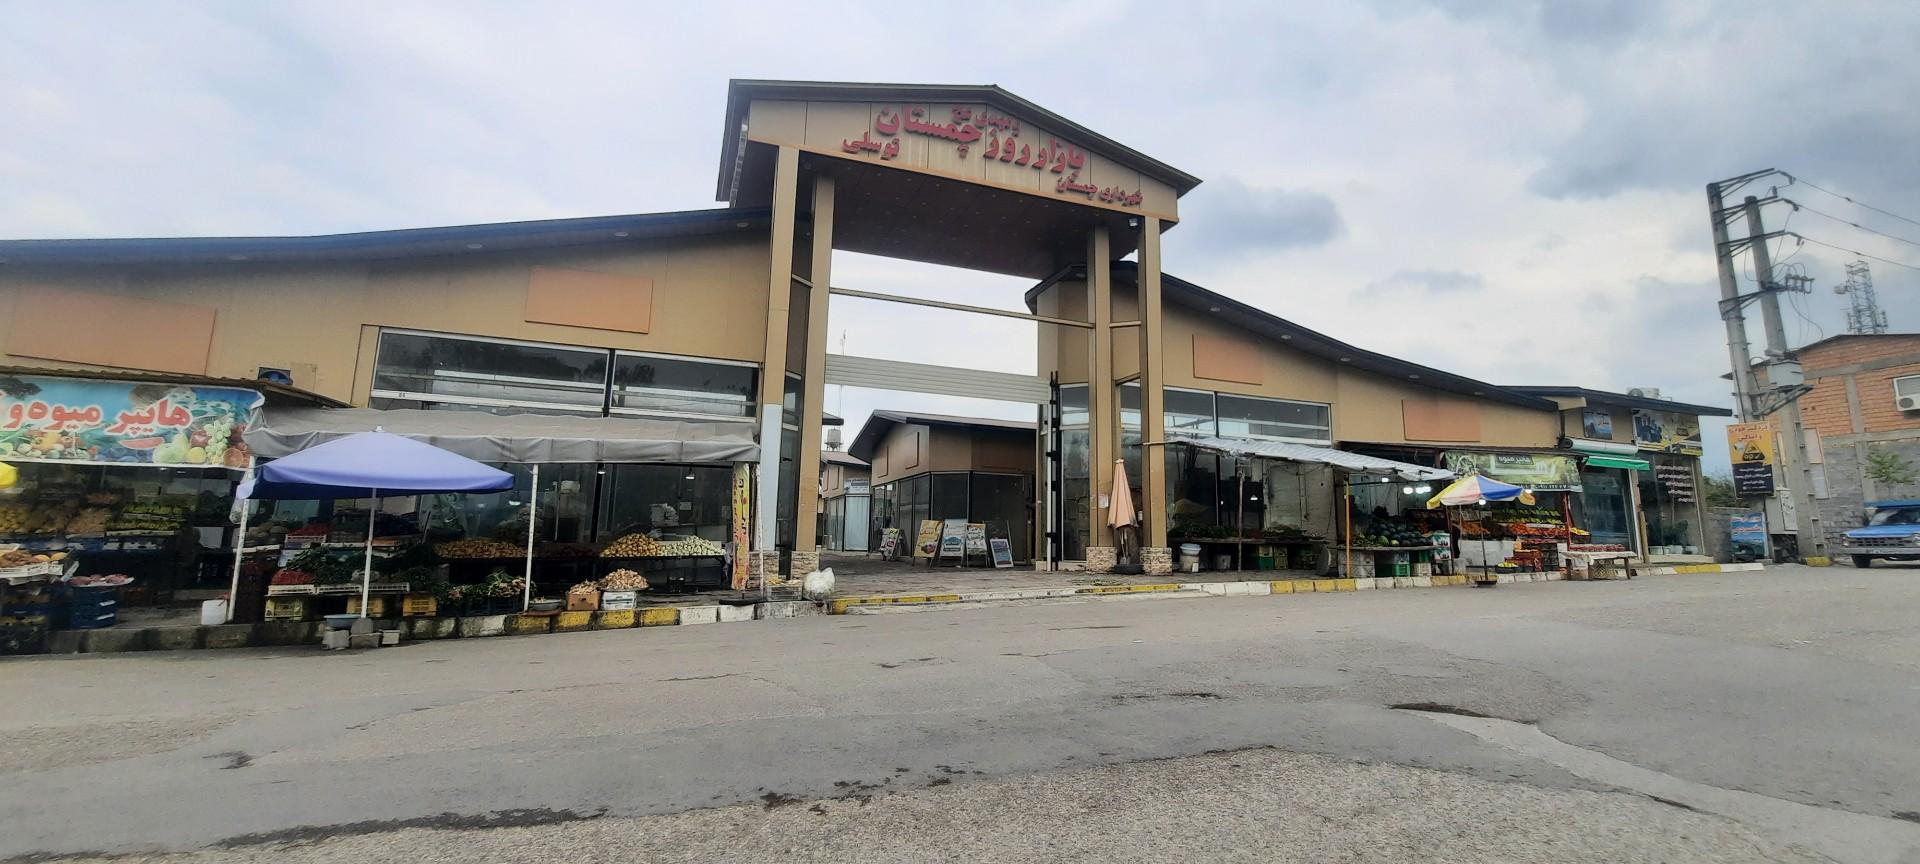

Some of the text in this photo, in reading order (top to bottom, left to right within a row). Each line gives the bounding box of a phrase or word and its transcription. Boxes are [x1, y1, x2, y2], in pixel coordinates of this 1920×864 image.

[843, 131, 900, 160] توسلی
[876, 103, 1085, 177] بازار روز چمستان
[1056, 174, 1144, 206] شهرداری چمستان
[3, 399, 191, 435] هایپر میوه و
